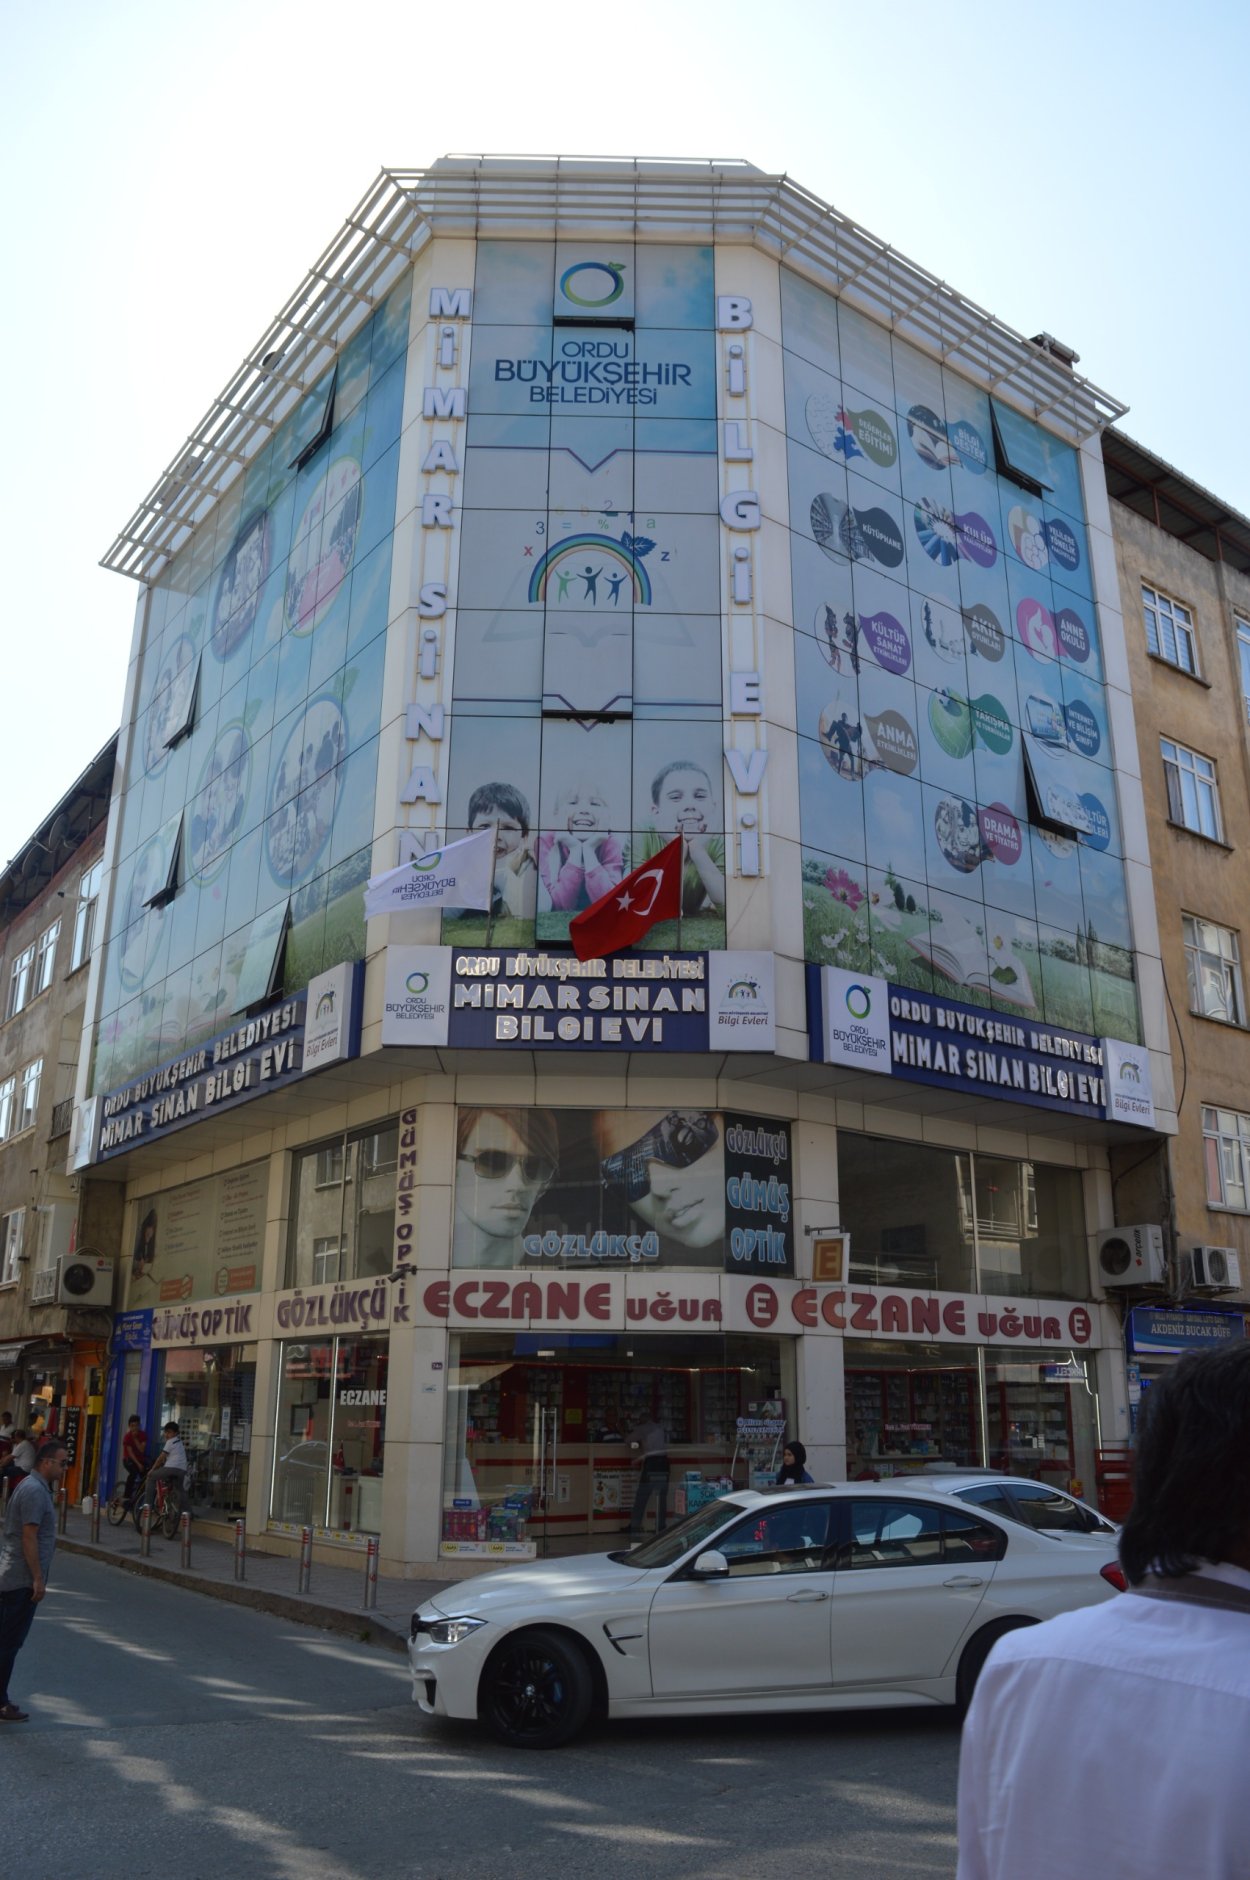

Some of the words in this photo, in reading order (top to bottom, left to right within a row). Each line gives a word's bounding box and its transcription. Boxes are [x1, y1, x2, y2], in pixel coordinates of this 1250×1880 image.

[561, 342, 629, 359] ORDU
[536, 521, 545, 535] 3
[871, 620, 906, 647] KÜLTÜR
[1060, 618, 1085, 640] ANNE
[1060, 630, 1086, 650] OKULU
[877, 636, 903, 656] SANAT
[877, 721, 915, 750] ANMA
[984, 817, 1017, 841] DRAMA
[456, 956, 500, 976] ORDU
[718, 1015, 740, 1027] Bilgi
[742, 1015, 768, 1025] Evleri
[890, 996, 930, 1024] ORDU
[850, 1024, 869, 1036] ORDU
[104, 1091, 130, 1118] ORDU
[1115, 1098, 1130, 1112] Bilgi
[1131, 1101, 1150, 1115] Evleri
[726, 1123, 787, 1165] GÖZLÜKÇÜ
[398, 1108, 417, 1216] GÜMÜŞ
[726, 1171, 789, 1223] GÜMÜŞ
[523, 1230, 659, 1262] GÖZLÜKÇÜ
[730, 1224, 787, 1264] OPTİK
[1134, 1229, 1142, 1257] arçelik
[277, 1280, 386, 1330] GÖZLÜKÇÜ
[422, 1280, 611, 1320] ECZANE
[626, 1291, 722, 1322] UĞUR
[792, 1288, 966, 1335] ECZANE
[978, 1306, 1061, 1340] UĞUR
[200, 1300, 252, 1336] OPTİK
[1151, 1322, 1185, 1336] AKDENİZ
[1186, 1325, 1212, 1337] BUCAK
[340, 1390, 386, 1405] ECZANE
